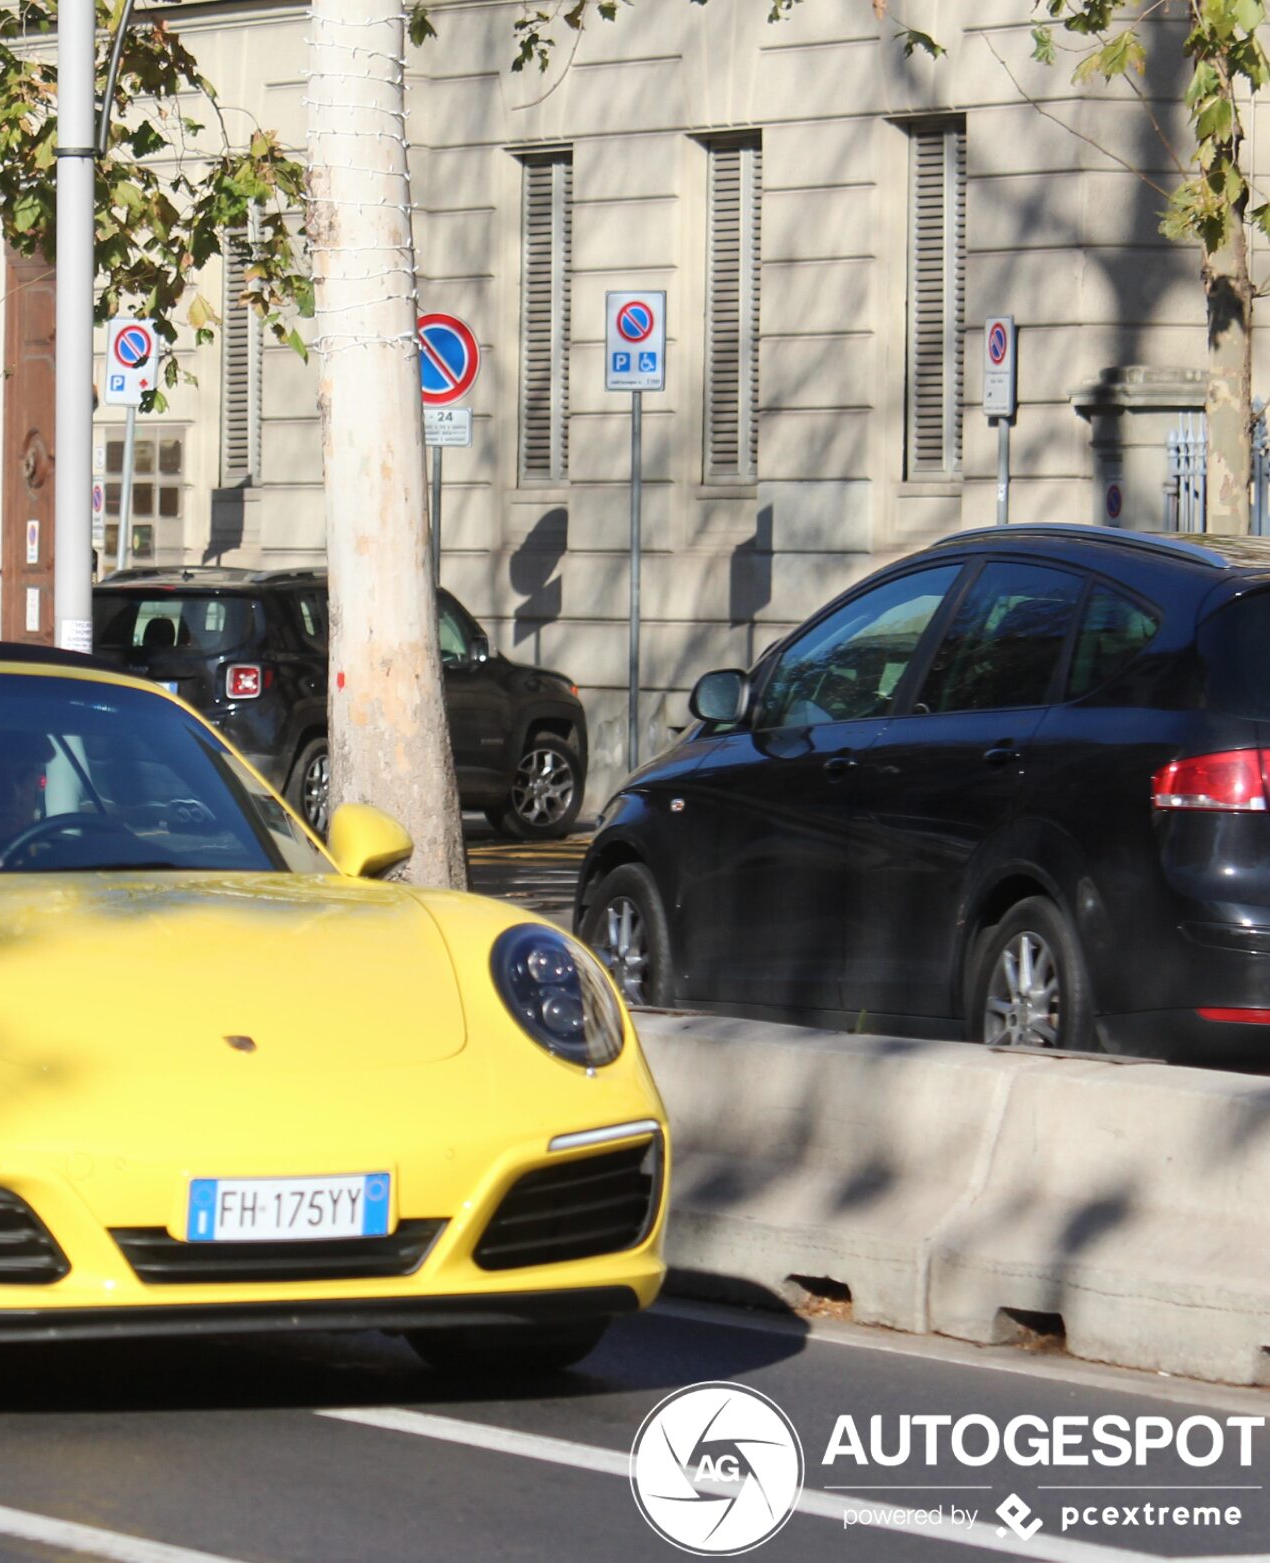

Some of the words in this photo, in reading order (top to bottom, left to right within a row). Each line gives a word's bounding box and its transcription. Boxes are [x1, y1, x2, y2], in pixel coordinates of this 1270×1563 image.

[615, 354, 627, 371] P
[112, 377, 123, 390] P
[437, 411, 453, 422] 24
